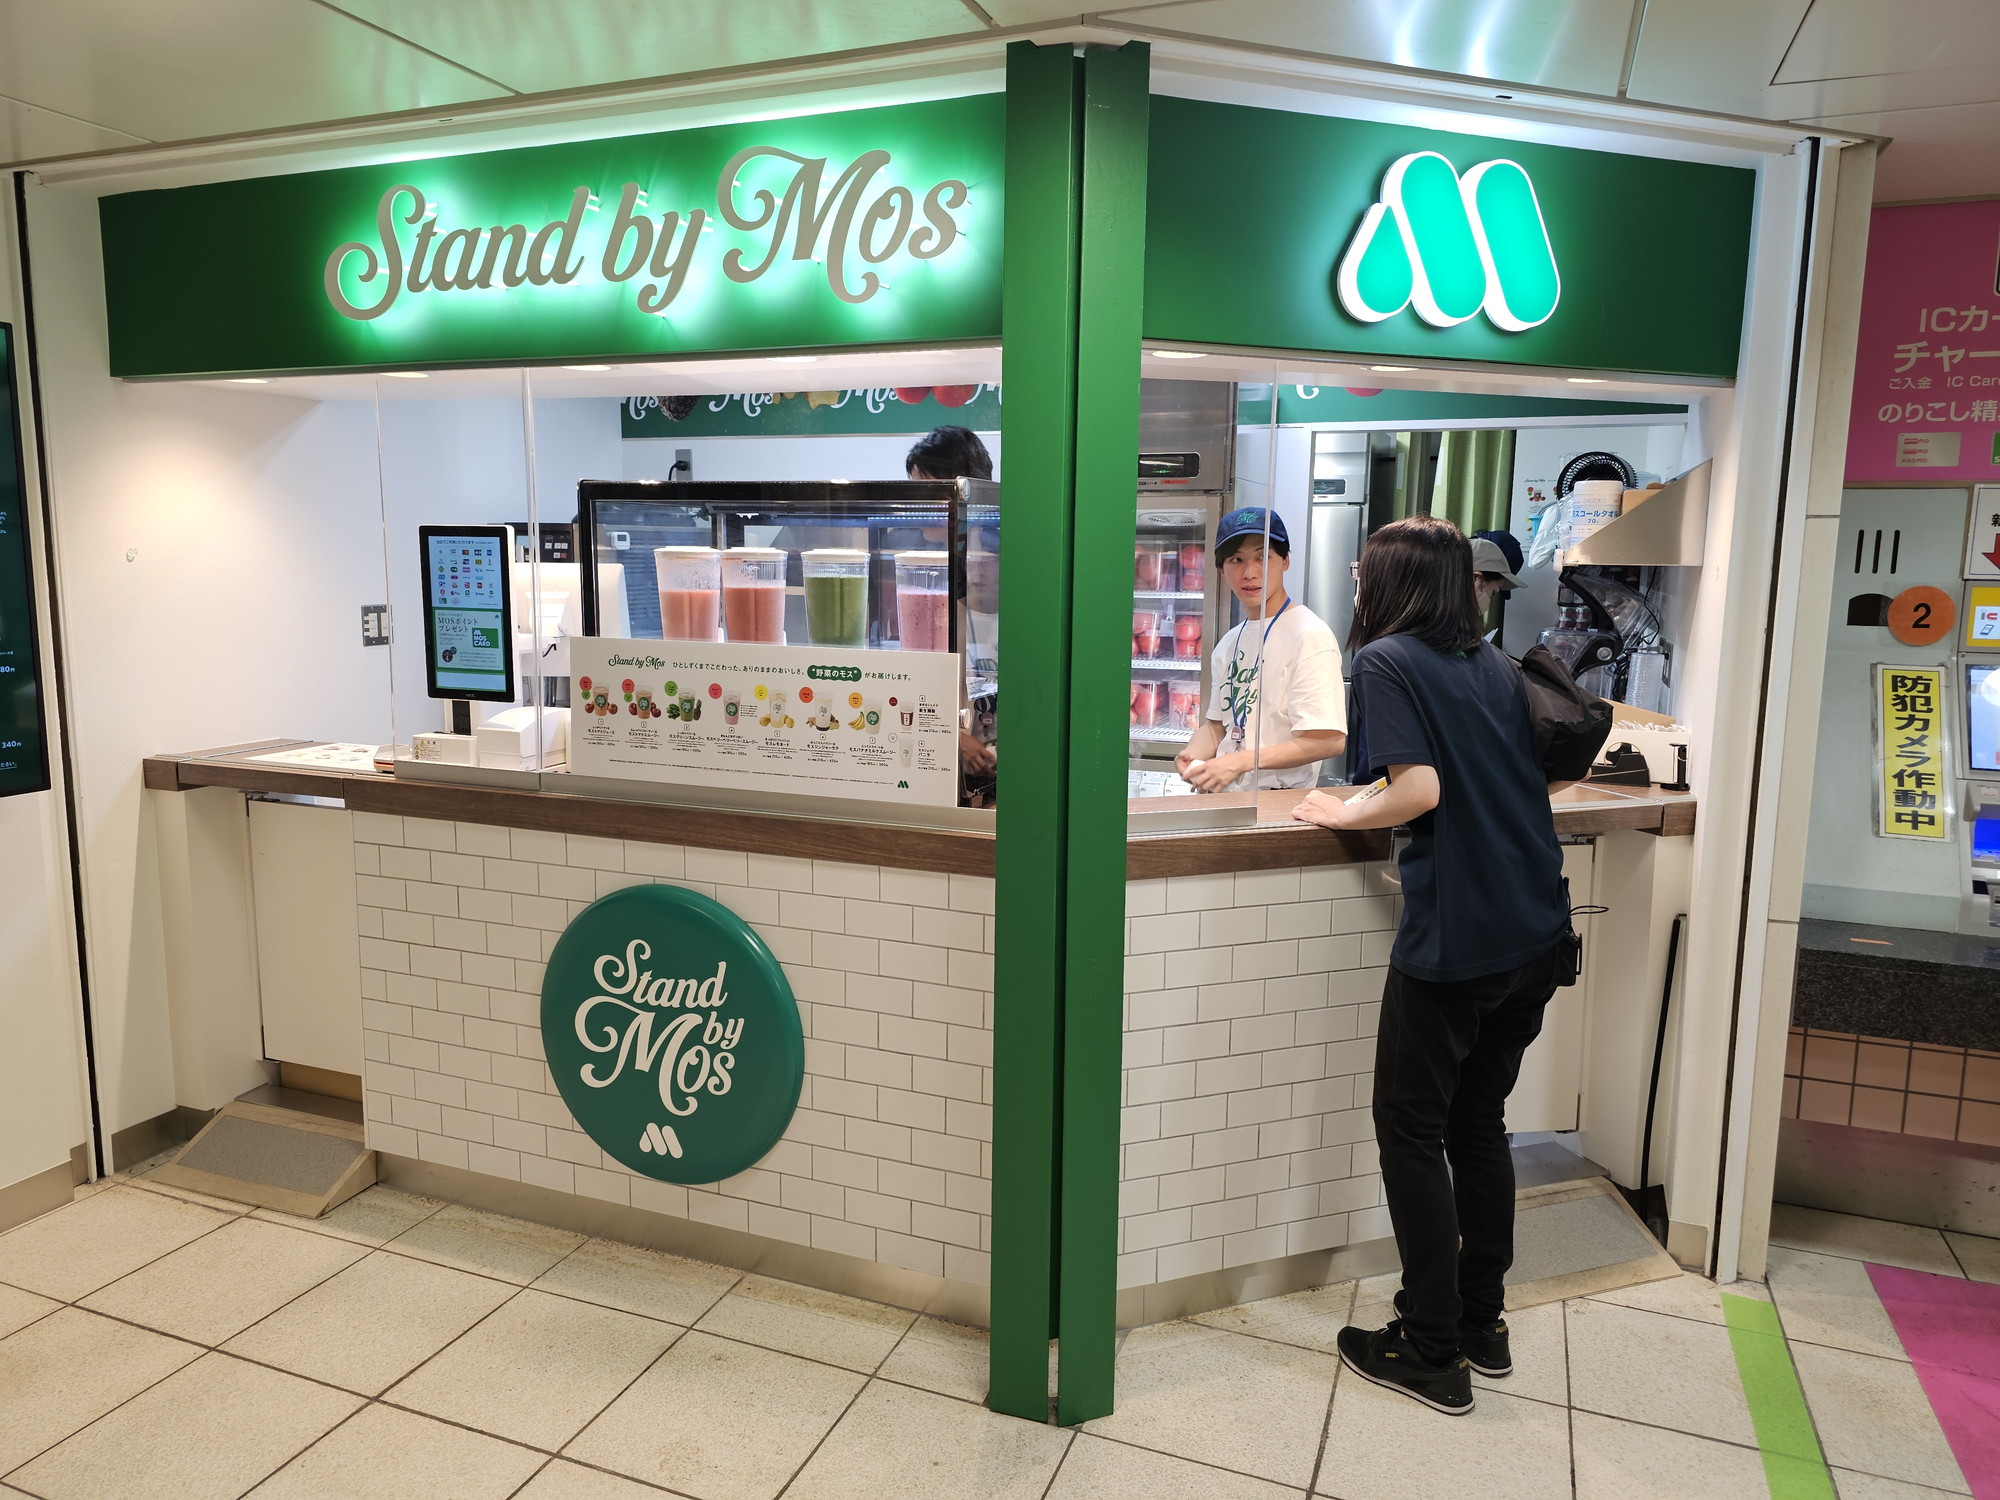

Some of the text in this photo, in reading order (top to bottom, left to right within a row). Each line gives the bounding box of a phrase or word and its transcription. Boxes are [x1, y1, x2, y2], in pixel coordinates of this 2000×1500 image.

[324, 146, 967, 321] Stand by Mos
[1889, 377, 1932, 390] ご入金
[1878, 400, 2000, 423] のりこし精
[437, 617, 478, 625] MOSポイント
[438, 625, 469, 633] プレゼント
[1912, 603, 1931, 629] 2
[608, 654, 633, 667] Stand
[634, 657, 645, 668] by
[645, 655, 666, 670] Mos
[864, 672, 912, 682] がお届けします。
[1891, 674, 1935, 831] 防犯カメラ作動中
[594, 938, 728, 1009] Stand
[703, 1011, 745, 1050] by
[574, 995, 736, 1117] Mos
